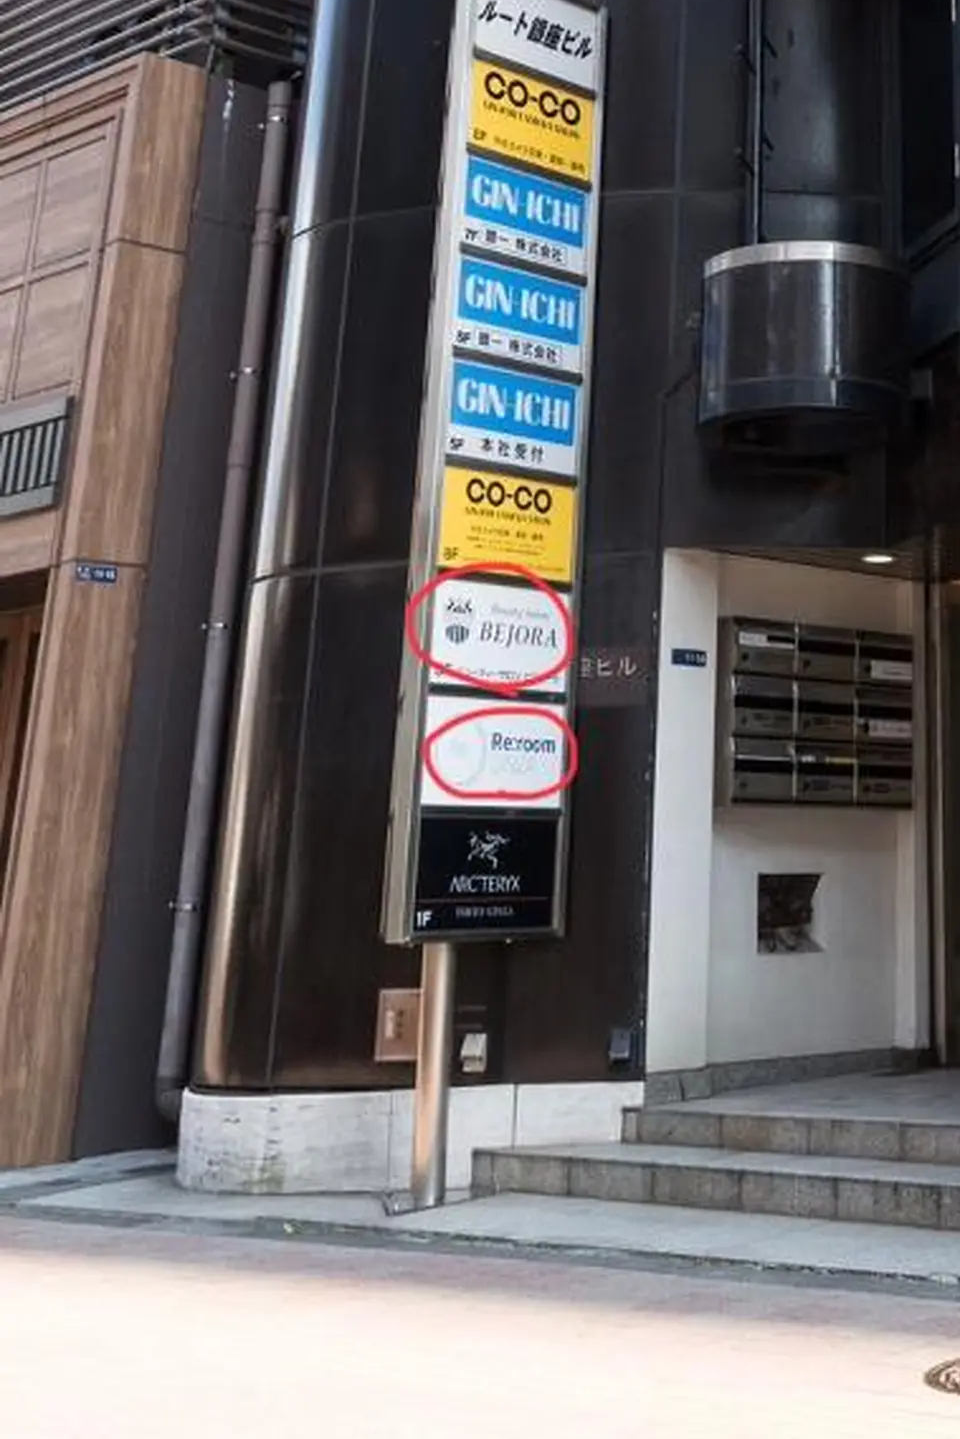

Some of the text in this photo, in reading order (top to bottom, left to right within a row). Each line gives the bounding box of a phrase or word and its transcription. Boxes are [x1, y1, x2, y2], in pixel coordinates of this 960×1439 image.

[477, 0, 593, 60] ルート銀座ビル
[484, 70, 581, 126] CO-CO
[480, 437, 545, 464] 本社受付
[466, 478, 552, 514] CO-CO
[479, 620, 558, 649] BEJORA
[416, 910, 432, 928] 1F
